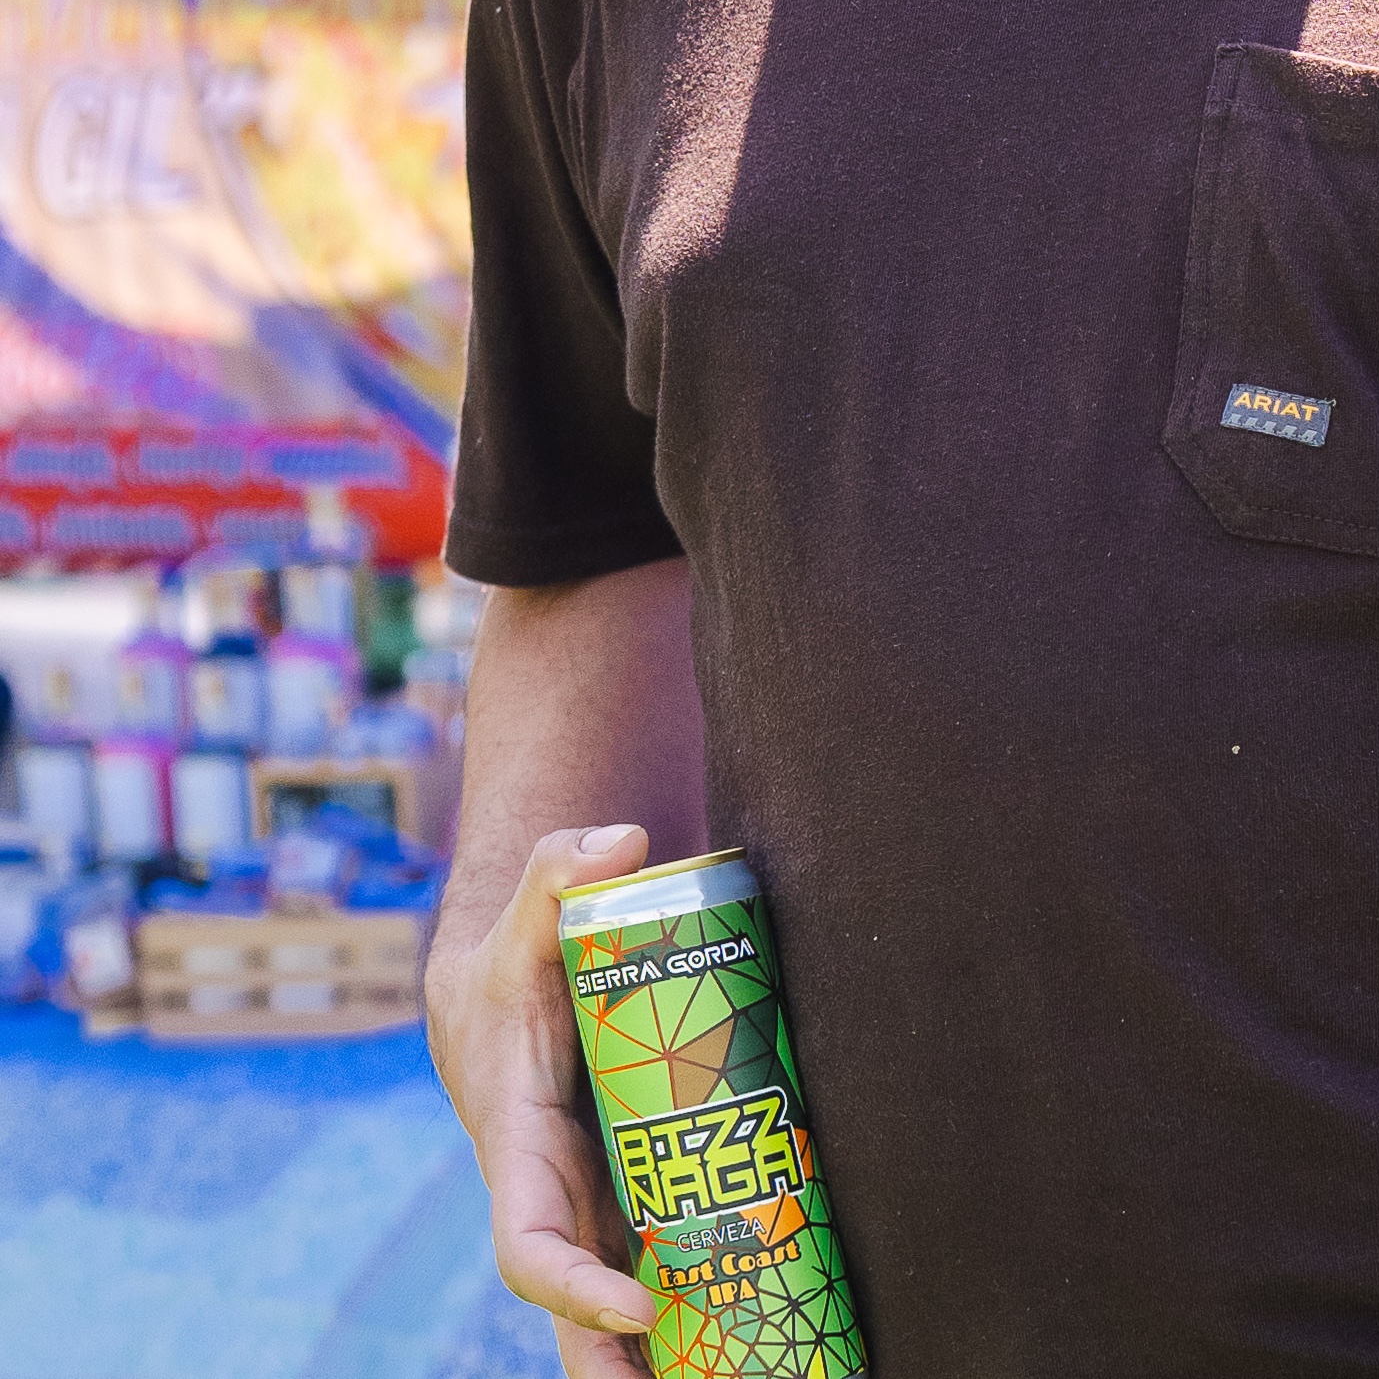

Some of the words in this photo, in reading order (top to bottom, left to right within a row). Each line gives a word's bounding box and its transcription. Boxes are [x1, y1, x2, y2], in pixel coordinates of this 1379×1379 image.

[1233, 391, 1319, 422] ARIAT
[576, 960, 663, 995] SIERRA
[666, 937, 756, 974] GORDA
[616, 1096, 788, 1176] BIZZ
[627, 1140, 798, 1221] NAGA
[676, 1218, 766, 1252] CERVEZA
[658, 1260, 717, 1289] East
[721, 1239, 800, 1276] Coast
[708, 1278, 758, 1307] IPA
